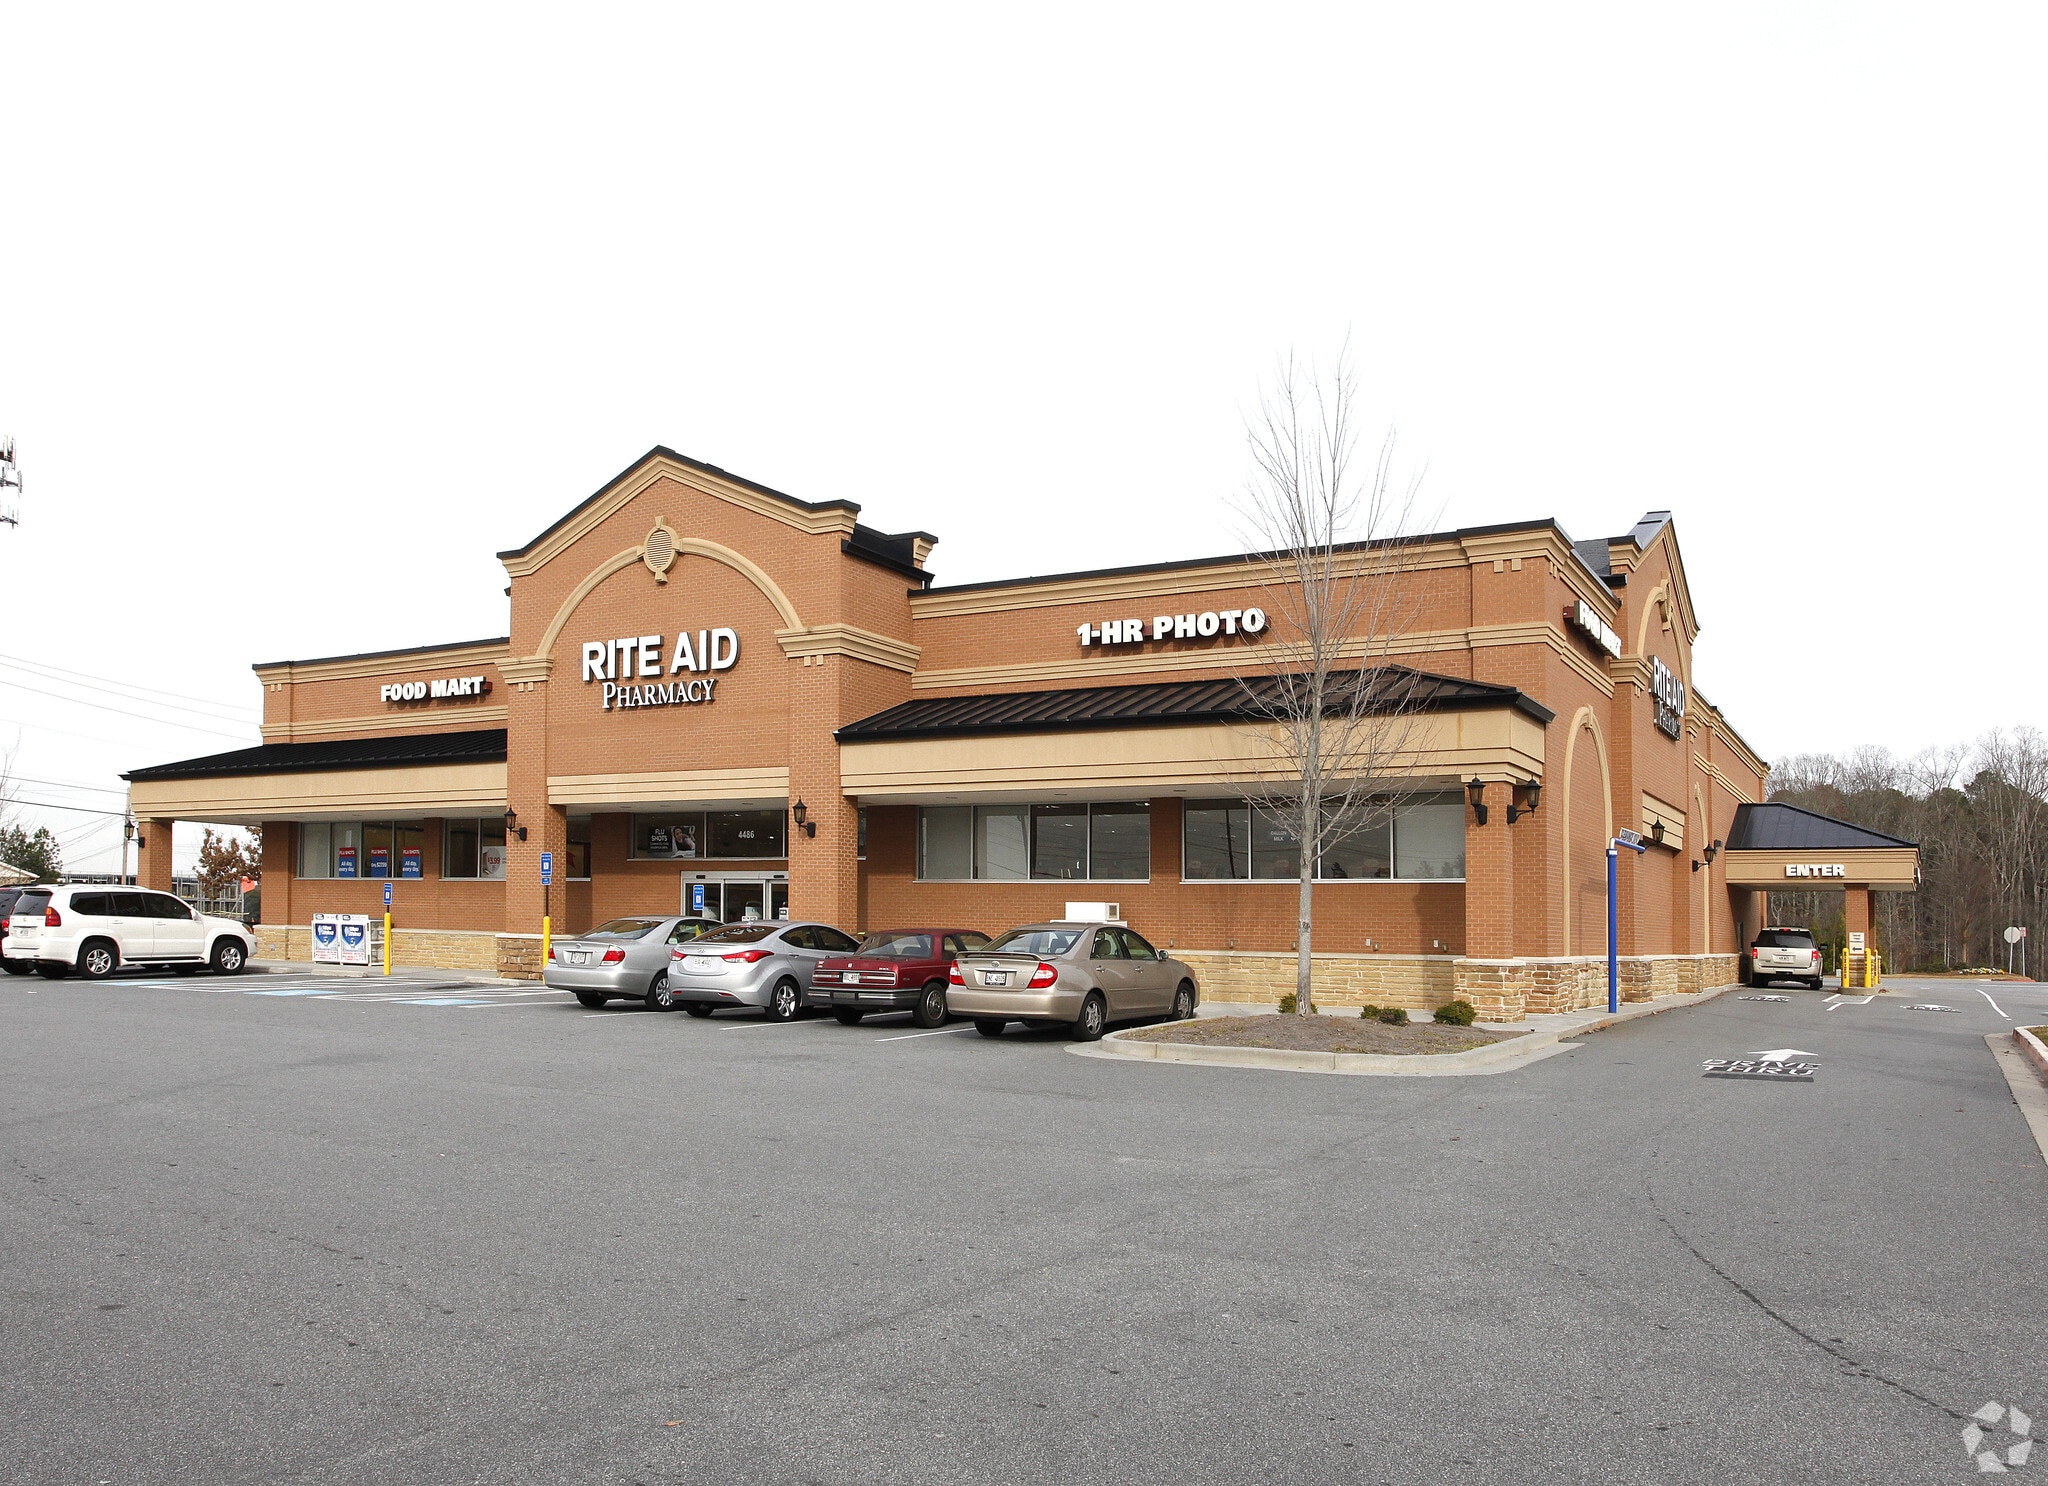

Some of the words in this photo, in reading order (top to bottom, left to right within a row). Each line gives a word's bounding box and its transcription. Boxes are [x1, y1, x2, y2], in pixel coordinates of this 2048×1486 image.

[1076, 618, 1145, 646] 1-HR
[1153, 607, 1267, 641] PHOTO
[582, 634, 664, 682] RITE
[669, 627, 739, 674] AID
[380, 681, 427, 702] FOOD
[430, 676, 485, 698] MART
[602, 678, 718, 710] PHARMACY
[1653, 655, 1671, 707] RITE
[1672, 676, 1685, 718] AID
[738, 830, 755, 839] 4486
[1785, 864, 1845, 877] ENTER
[1702, 1059, 1822, 1070] DRIVE
[1702, 1065, 1814, 1076] THRU
